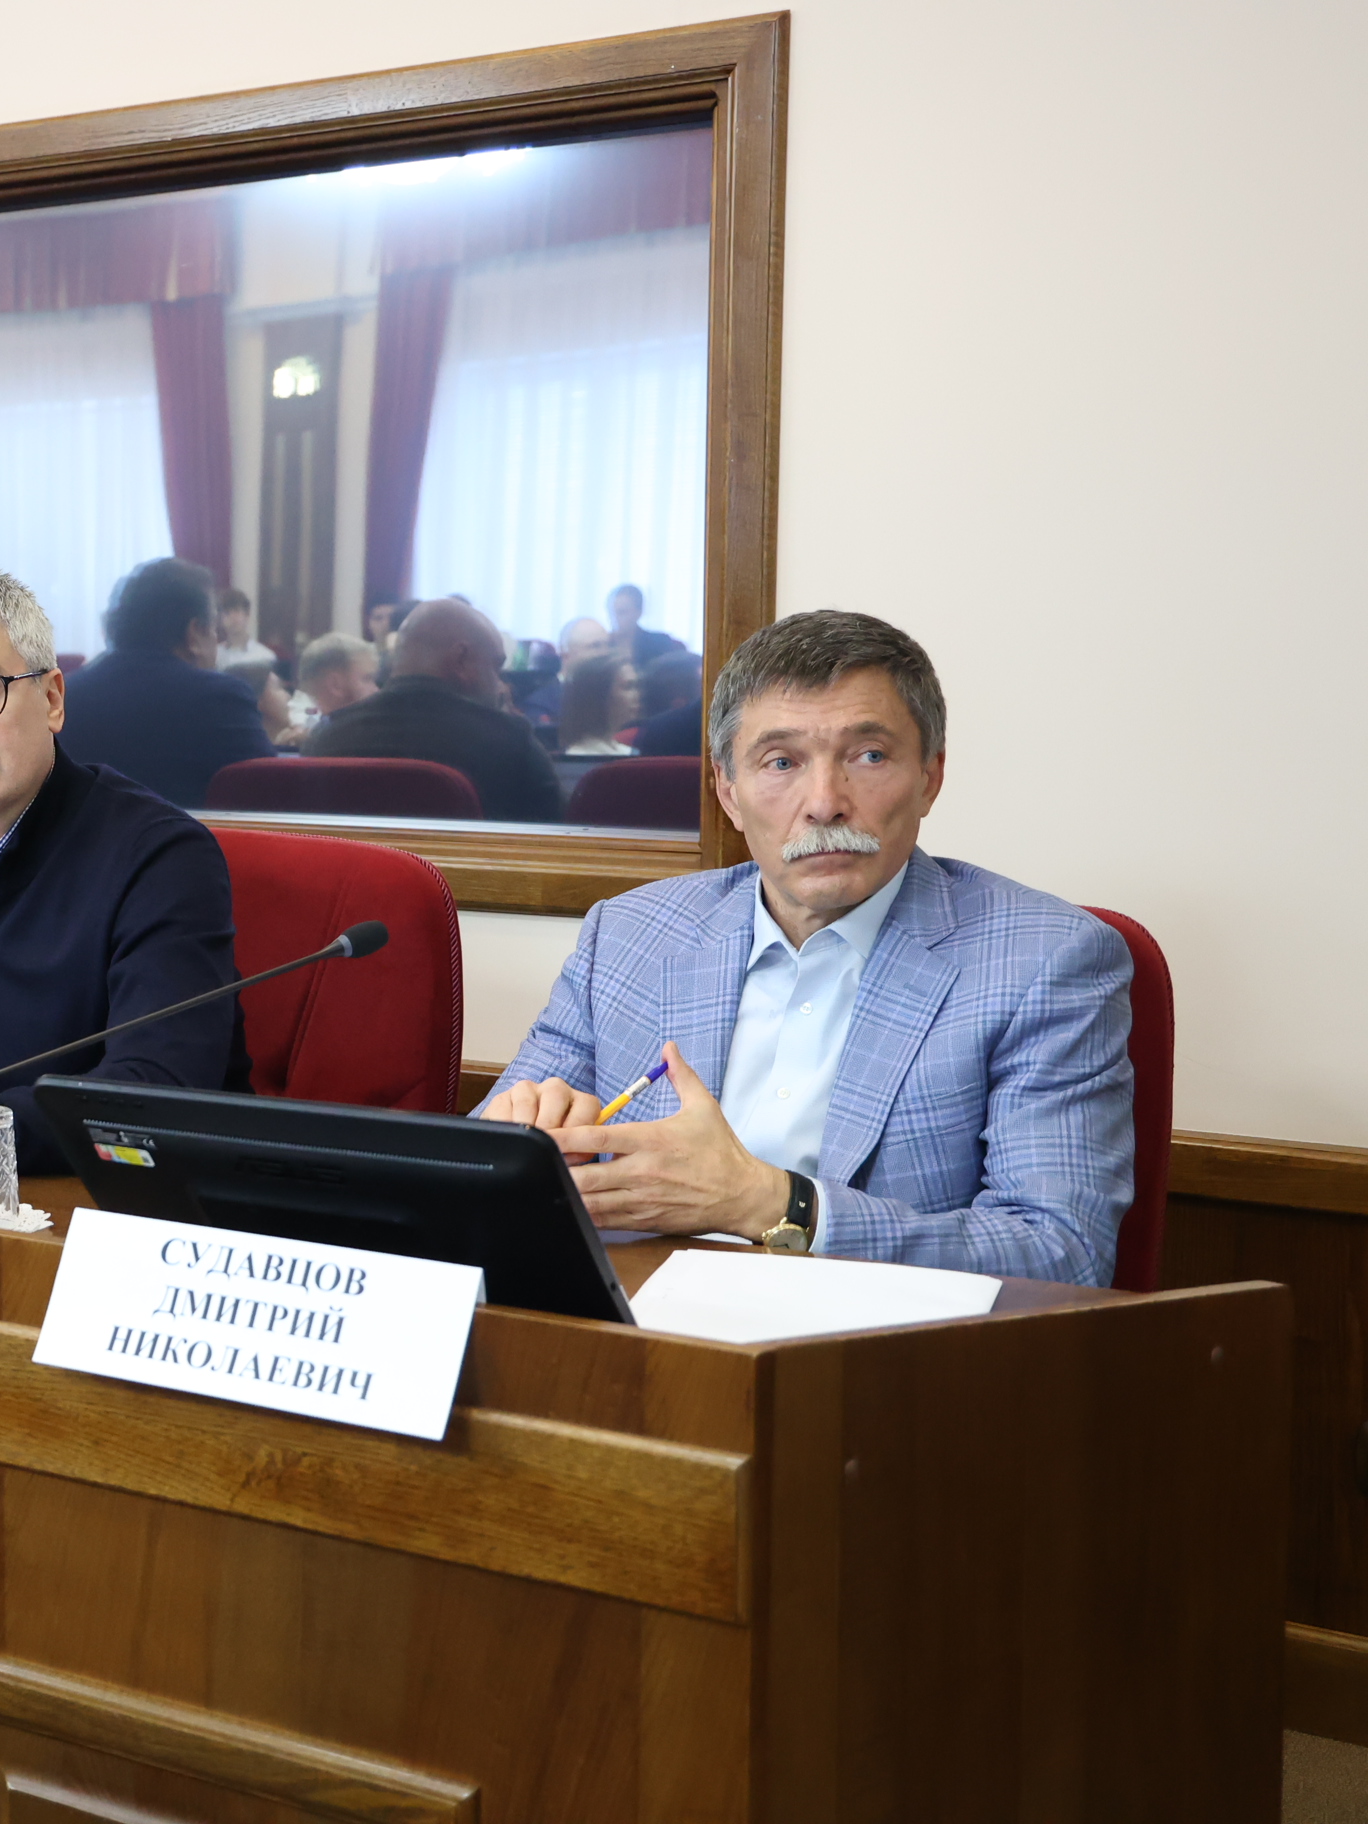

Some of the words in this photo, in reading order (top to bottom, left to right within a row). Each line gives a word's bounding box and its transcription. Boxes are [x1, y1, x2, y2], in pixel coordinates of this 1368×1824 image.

[160, 1237, 368, 1296] СУДАВЦОВ
[151, 1284, 347, 1344] ДМИТРИЙ
[106, 1324, 376, 1401] НИКОЛАЕВИЧ
